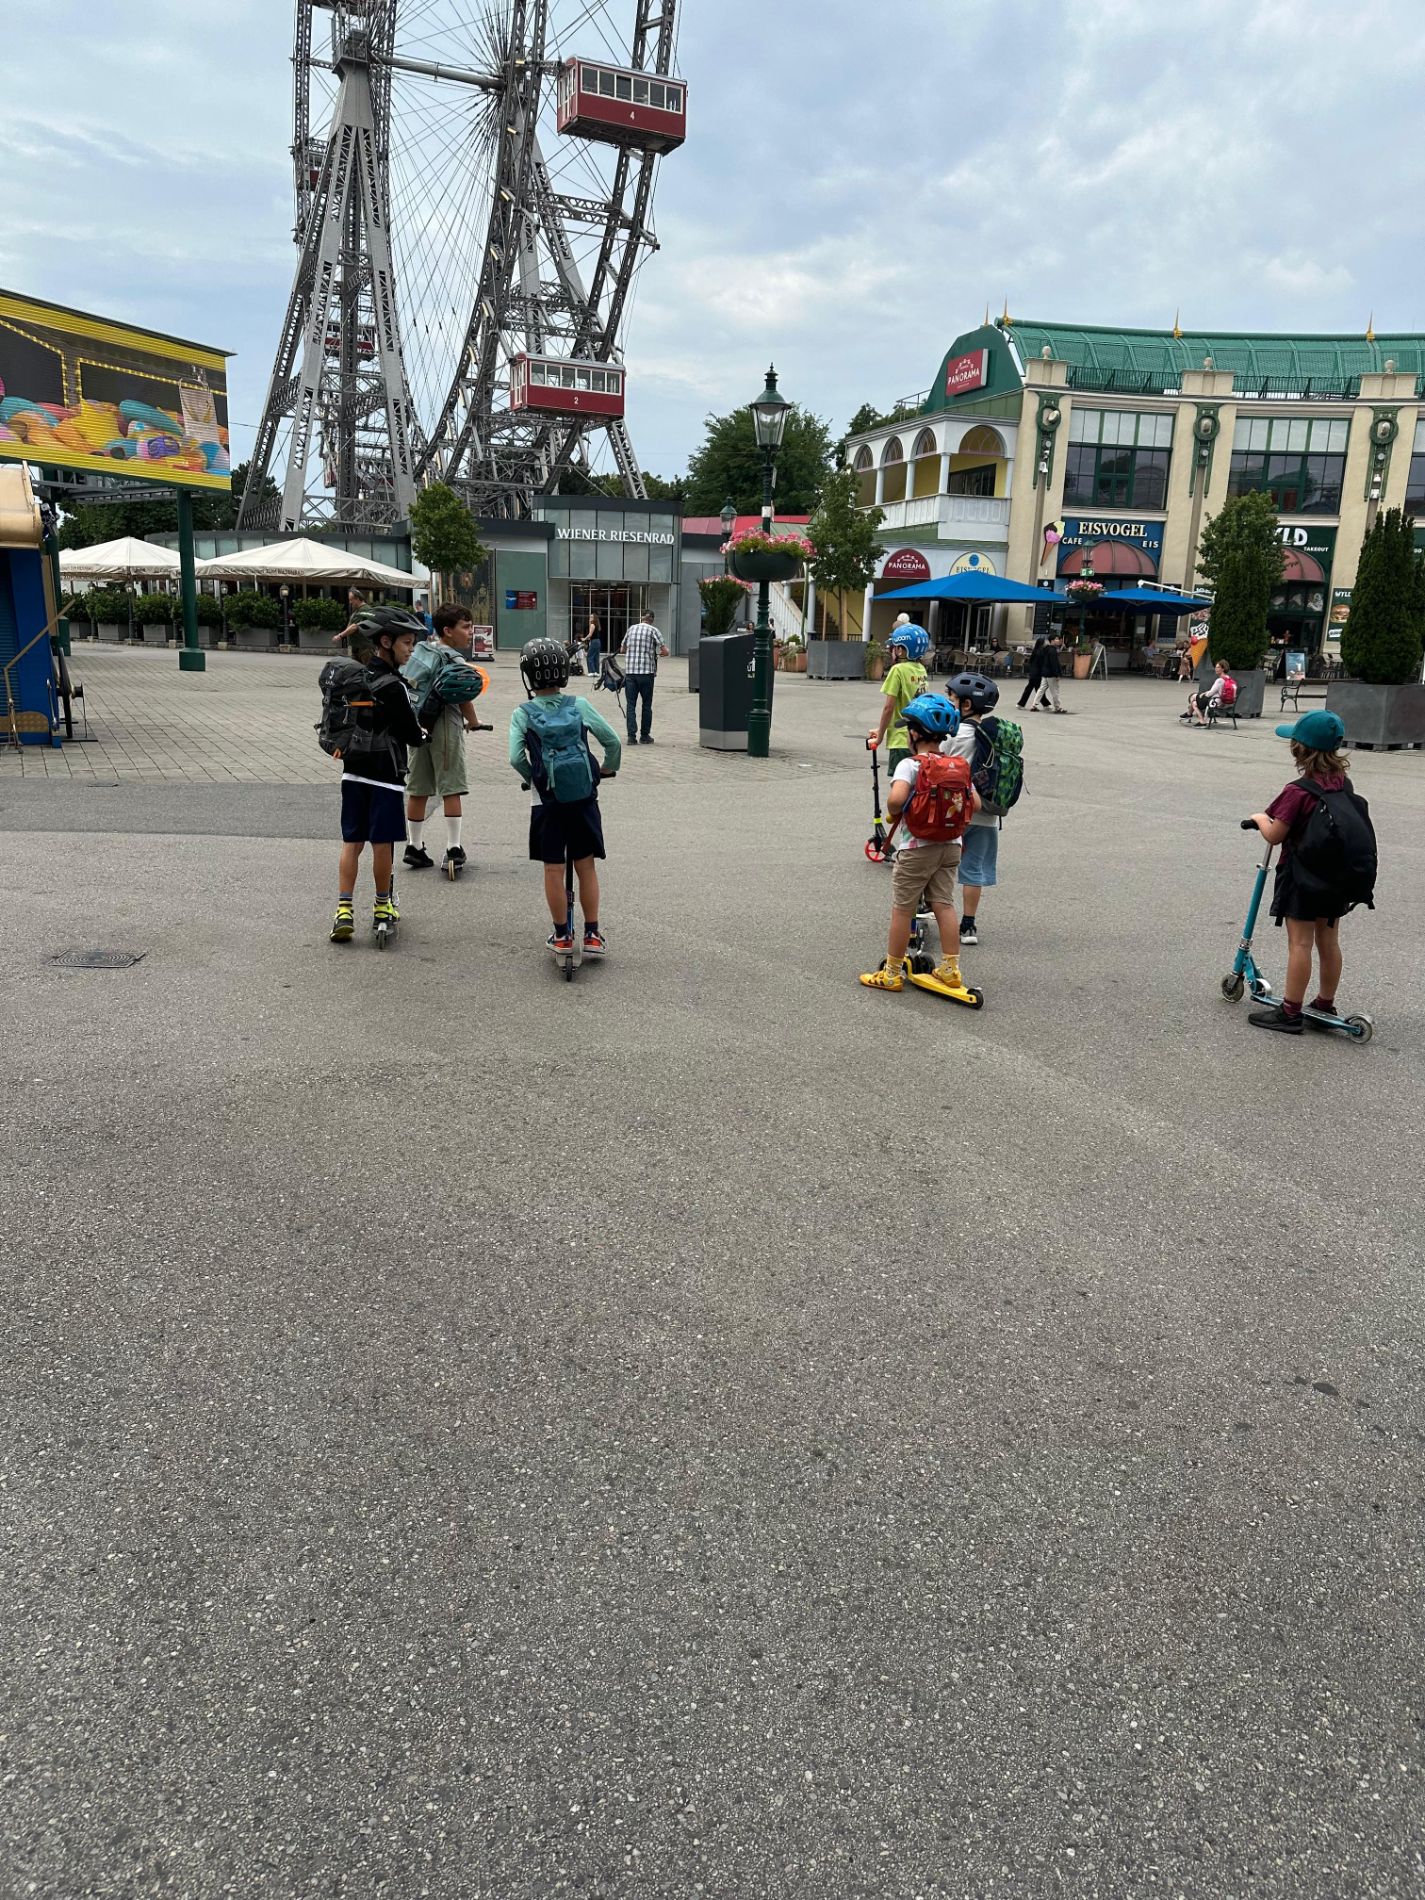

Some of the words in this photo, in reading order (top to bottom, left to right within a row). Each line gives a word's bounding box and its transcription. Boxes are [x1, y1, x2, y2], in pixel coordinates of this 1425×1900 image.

[630, 111, 635, 120] 4
[947, 368, 980, 385] PANORAMA
[574, 396, 579, 405] 2
[1078, 521, 1148, 538] EISVOGEL
[556, 528, 606, 541] WIENER
[610, 530, 675, 545] RIESENRAD
[1062, 537, 1083, 545] CAFE
[1142, 540, 1159, 548] EIS
[888, 562, 926, 570] PANORAMA
